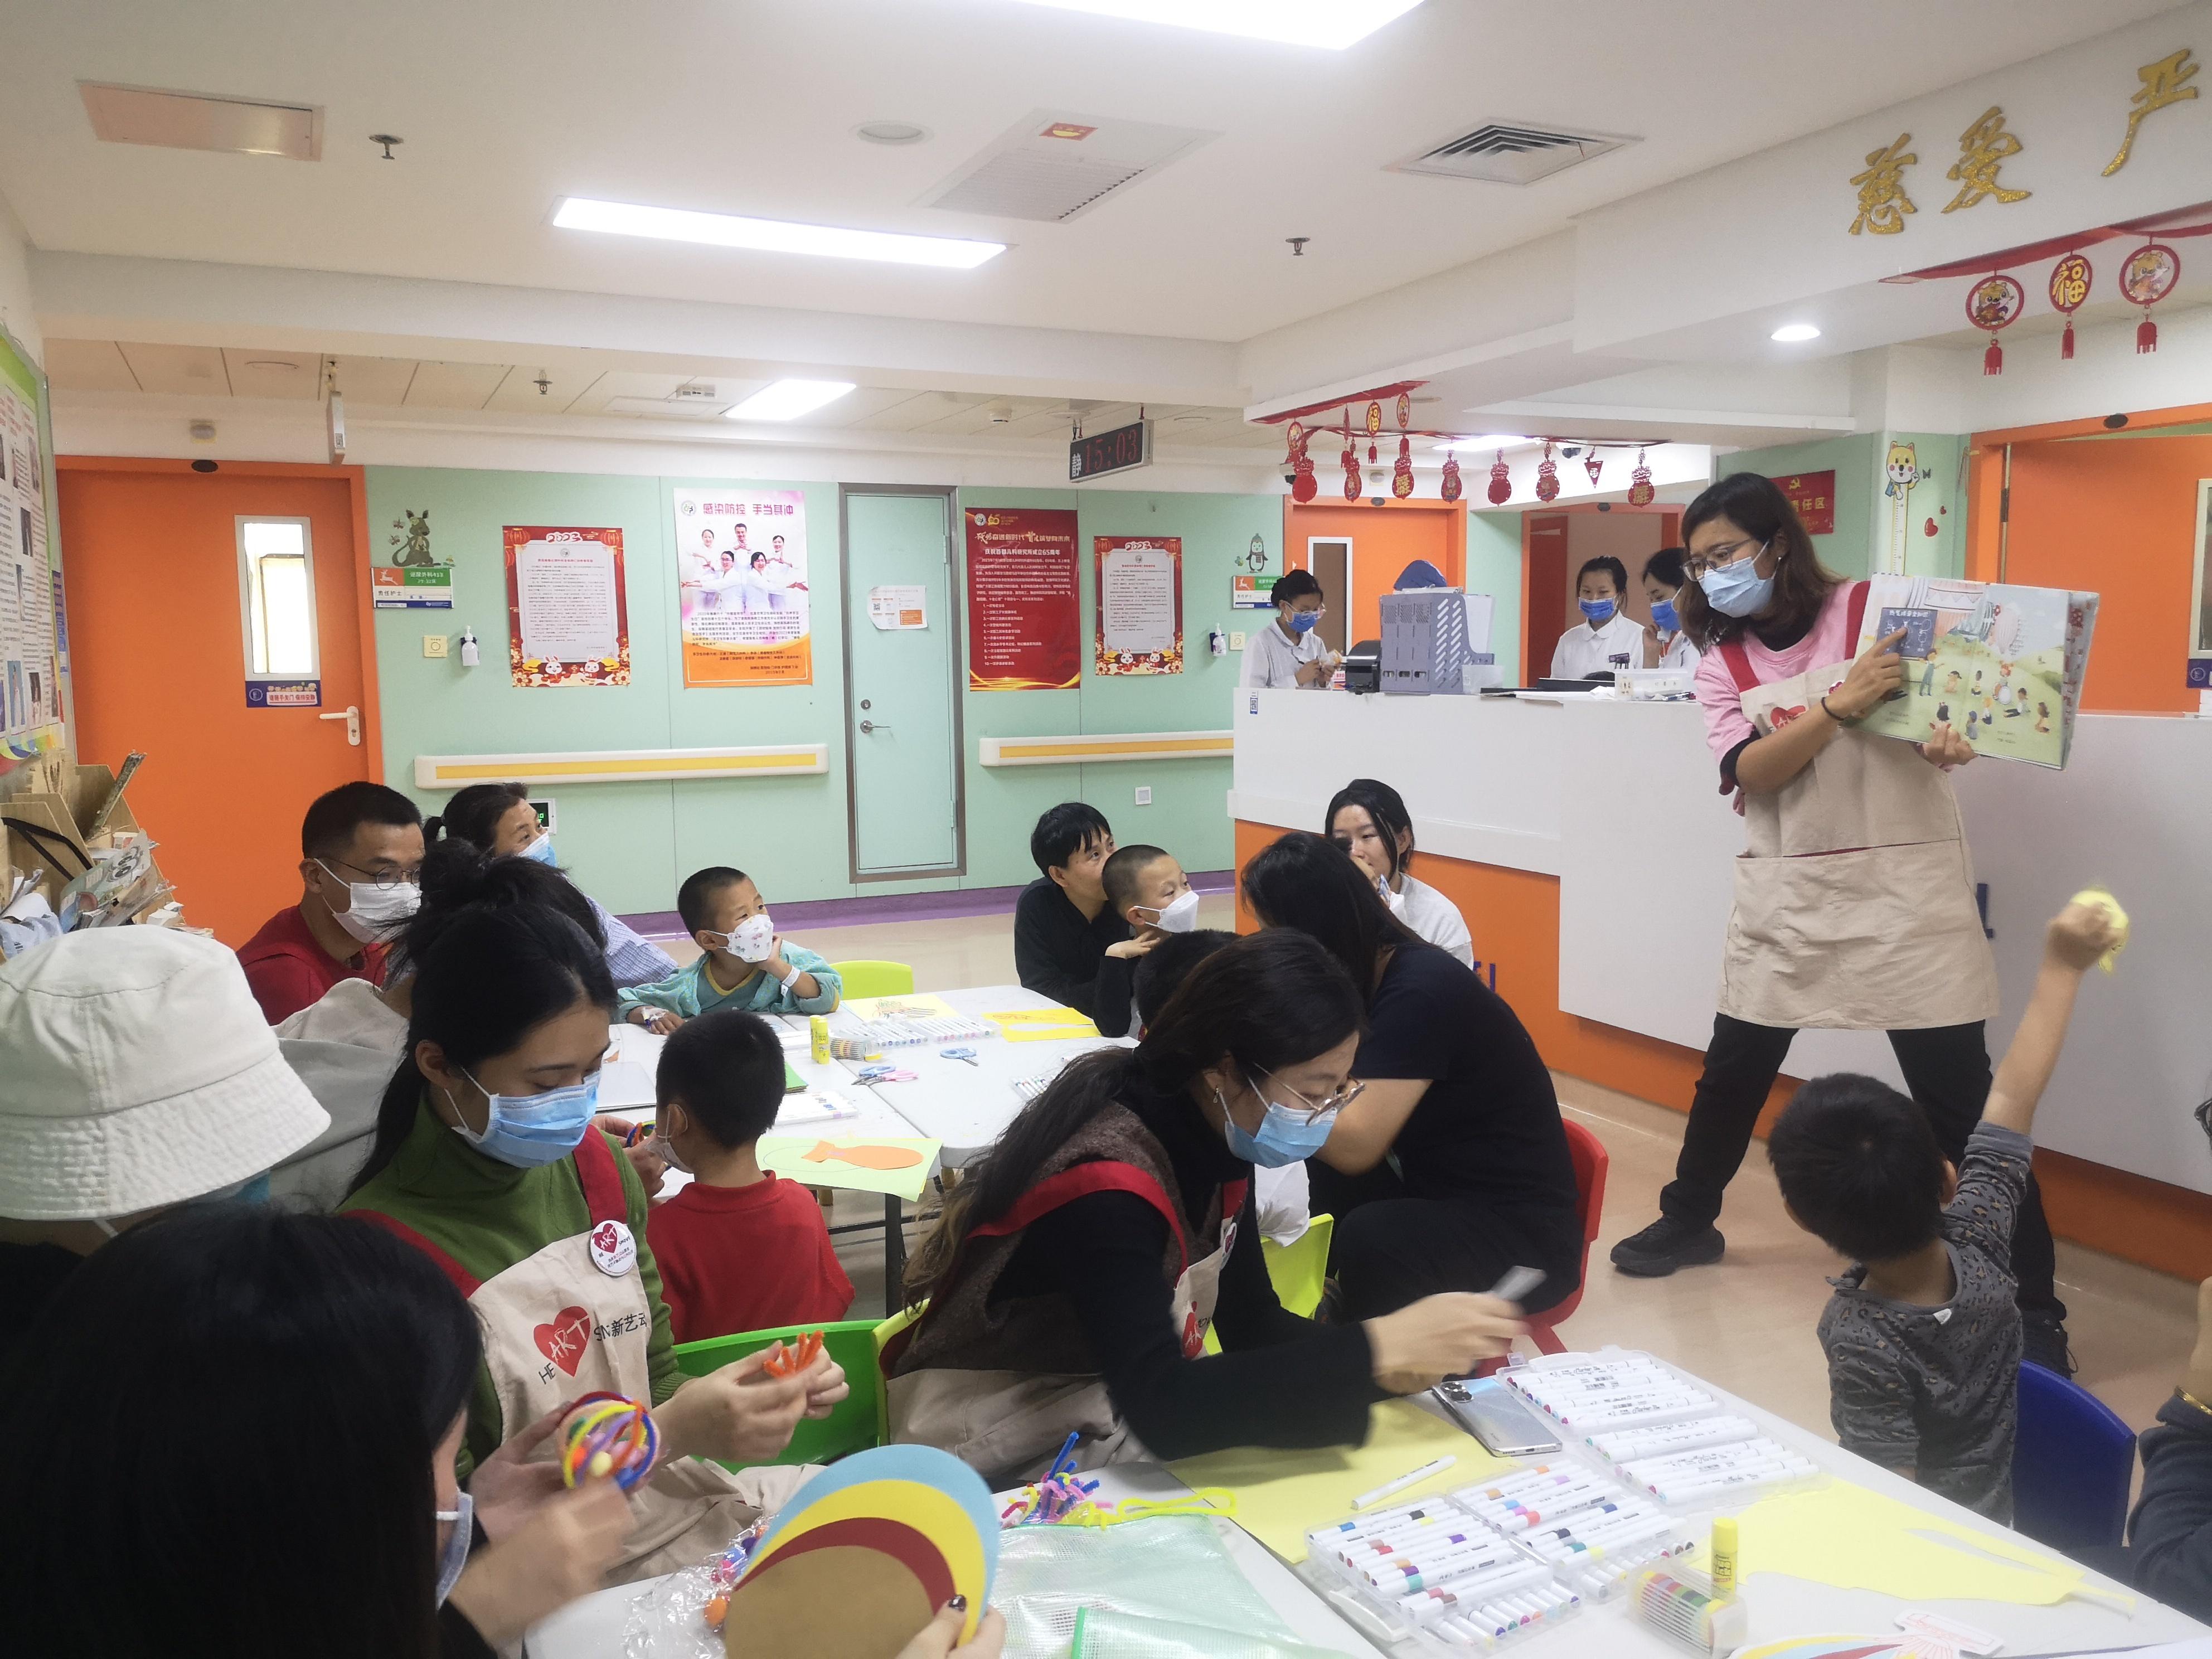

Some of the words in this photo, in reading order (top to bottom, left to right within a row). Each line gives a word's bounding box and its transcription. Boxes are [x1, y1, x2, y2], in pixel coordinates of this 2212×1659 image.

[2053, 260, 2086, 306] 福
[1085, 429, 1138, 473] 15:03
[703, 503, 745, 515] 感染防控
[753, 503, 794, 515] 手当其冲
[547, 532, 581, 542] 2023
[1126, 541, 1151, 550] 2023
[548, 1314, 590, 1361] ART
[539, 1362, 556, 1385] HE
